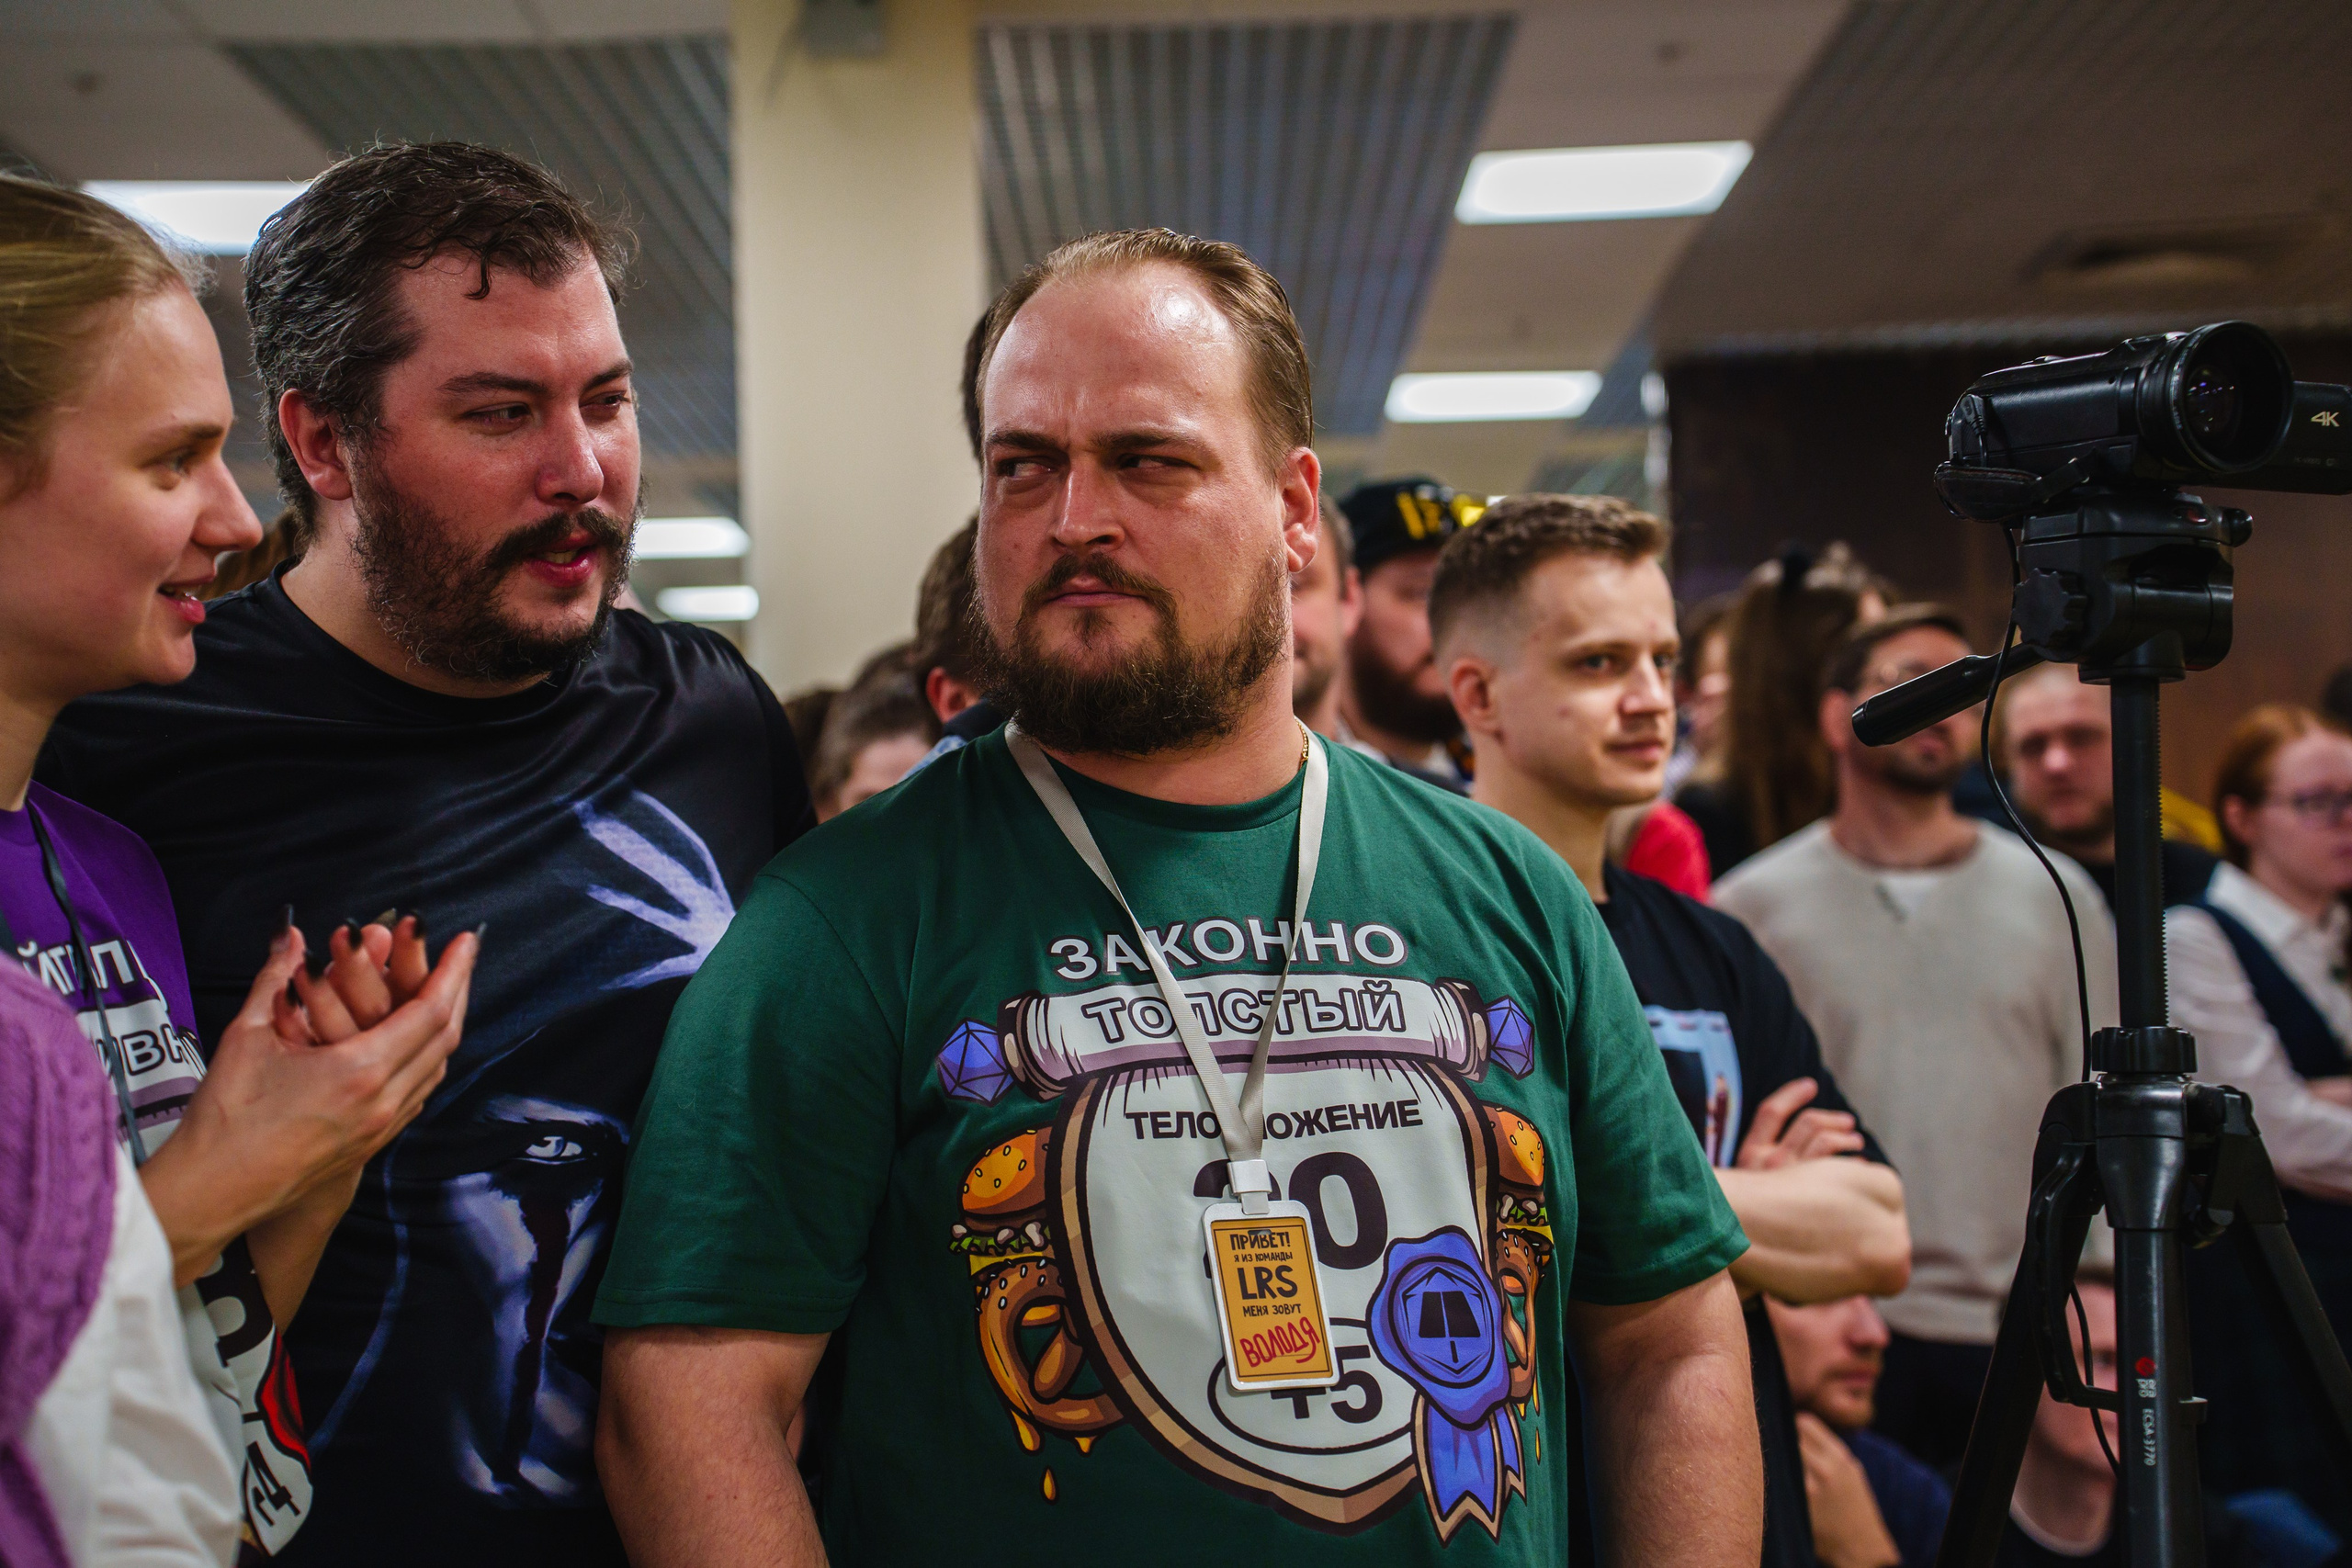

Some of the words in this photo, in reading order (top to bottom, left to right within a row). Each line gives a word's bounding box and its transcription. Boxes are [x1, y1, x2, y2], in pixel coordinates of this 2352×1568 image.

[2311, 411, 2340, 427] 4K
[1049, 918, 1408, 980] ЗАКОННО
[1125, 1099, 1423, 1140] ТЕЛООЖЕНИЕ
[1229, 1231, 1291, 1250] ПРИВЕТ!
[1234, 1255, 1239, 1263] Я
[1241, 1254, 1253, 1262] ИЗ
[1255, 1251, 1293, 1262] КОМАНДЫ
[1237, 1265, 1298, 1300] LRS
[1243, 1305, 1269, 1317] МЕНЯ
[1272, 1303, 1302, 1315] ЗОВУТ
[1239, 1316, 1320, 1368] ВОЛОДЯ
